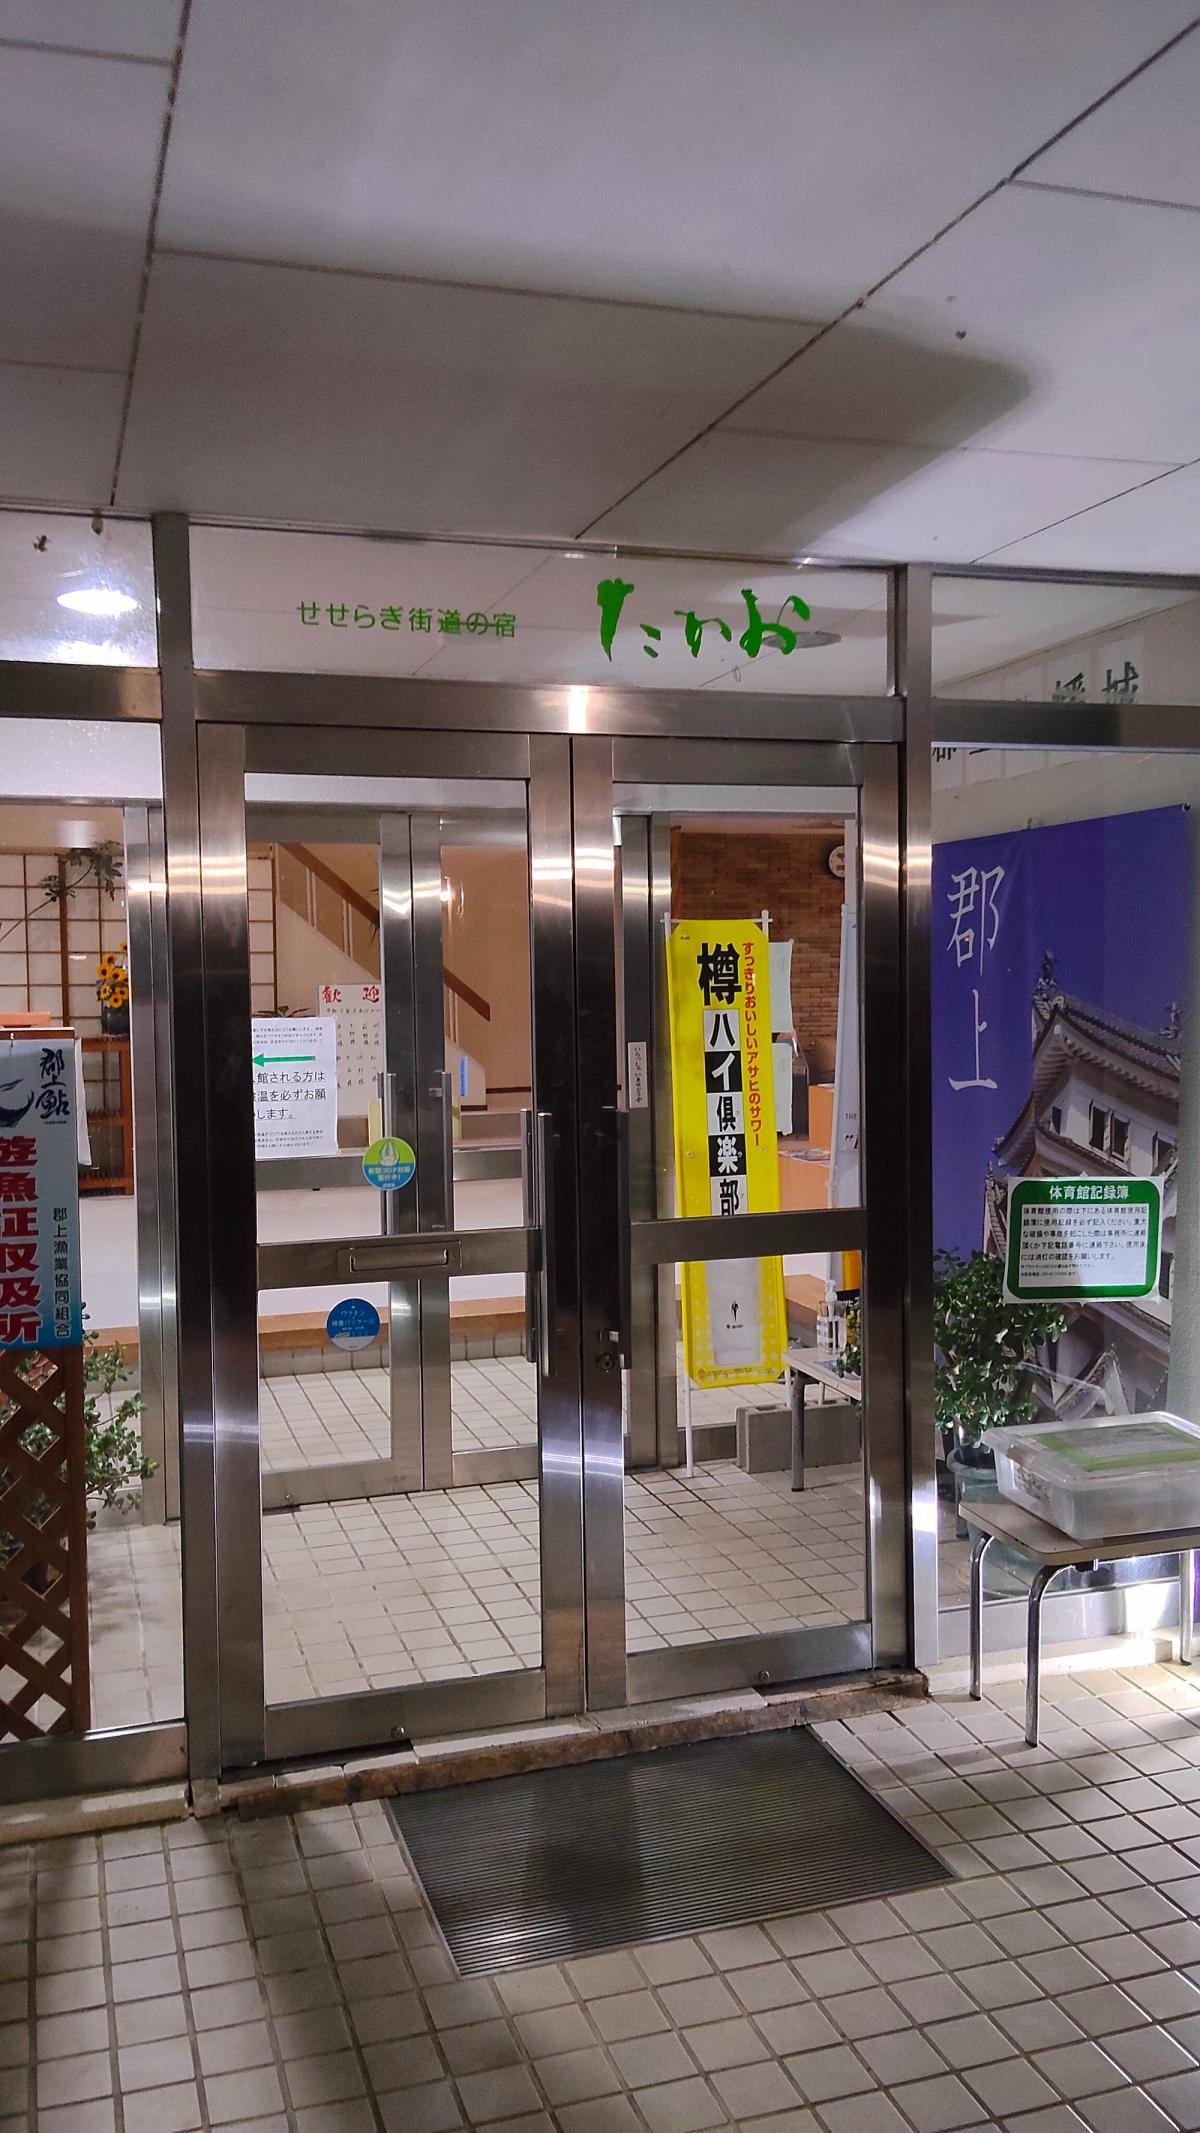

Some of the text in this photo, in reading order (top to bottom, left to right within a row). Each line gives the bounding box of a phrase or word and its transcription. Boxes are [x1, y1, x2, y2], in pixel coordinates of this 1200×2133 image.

[297, 601, 516, 637] せせらぎ街道の宿
[597, 581, 811, 662] たかお
[946, 866, 1006, 1091] 郡上
[253, 1072, 326, 1084] 館される方は
[696, 942, 742, 1216] 樽ハイ倶楽部
[742, 942, 762, 1147] すっきりおいしいアサヒのサワー
[253, 1088, 326, 1103] 温を必ずお願
[1049, 1185, 1130, 1200] 体育館記録簿
[52, 1207, 71, 1338] 郡上漁業協同組合
